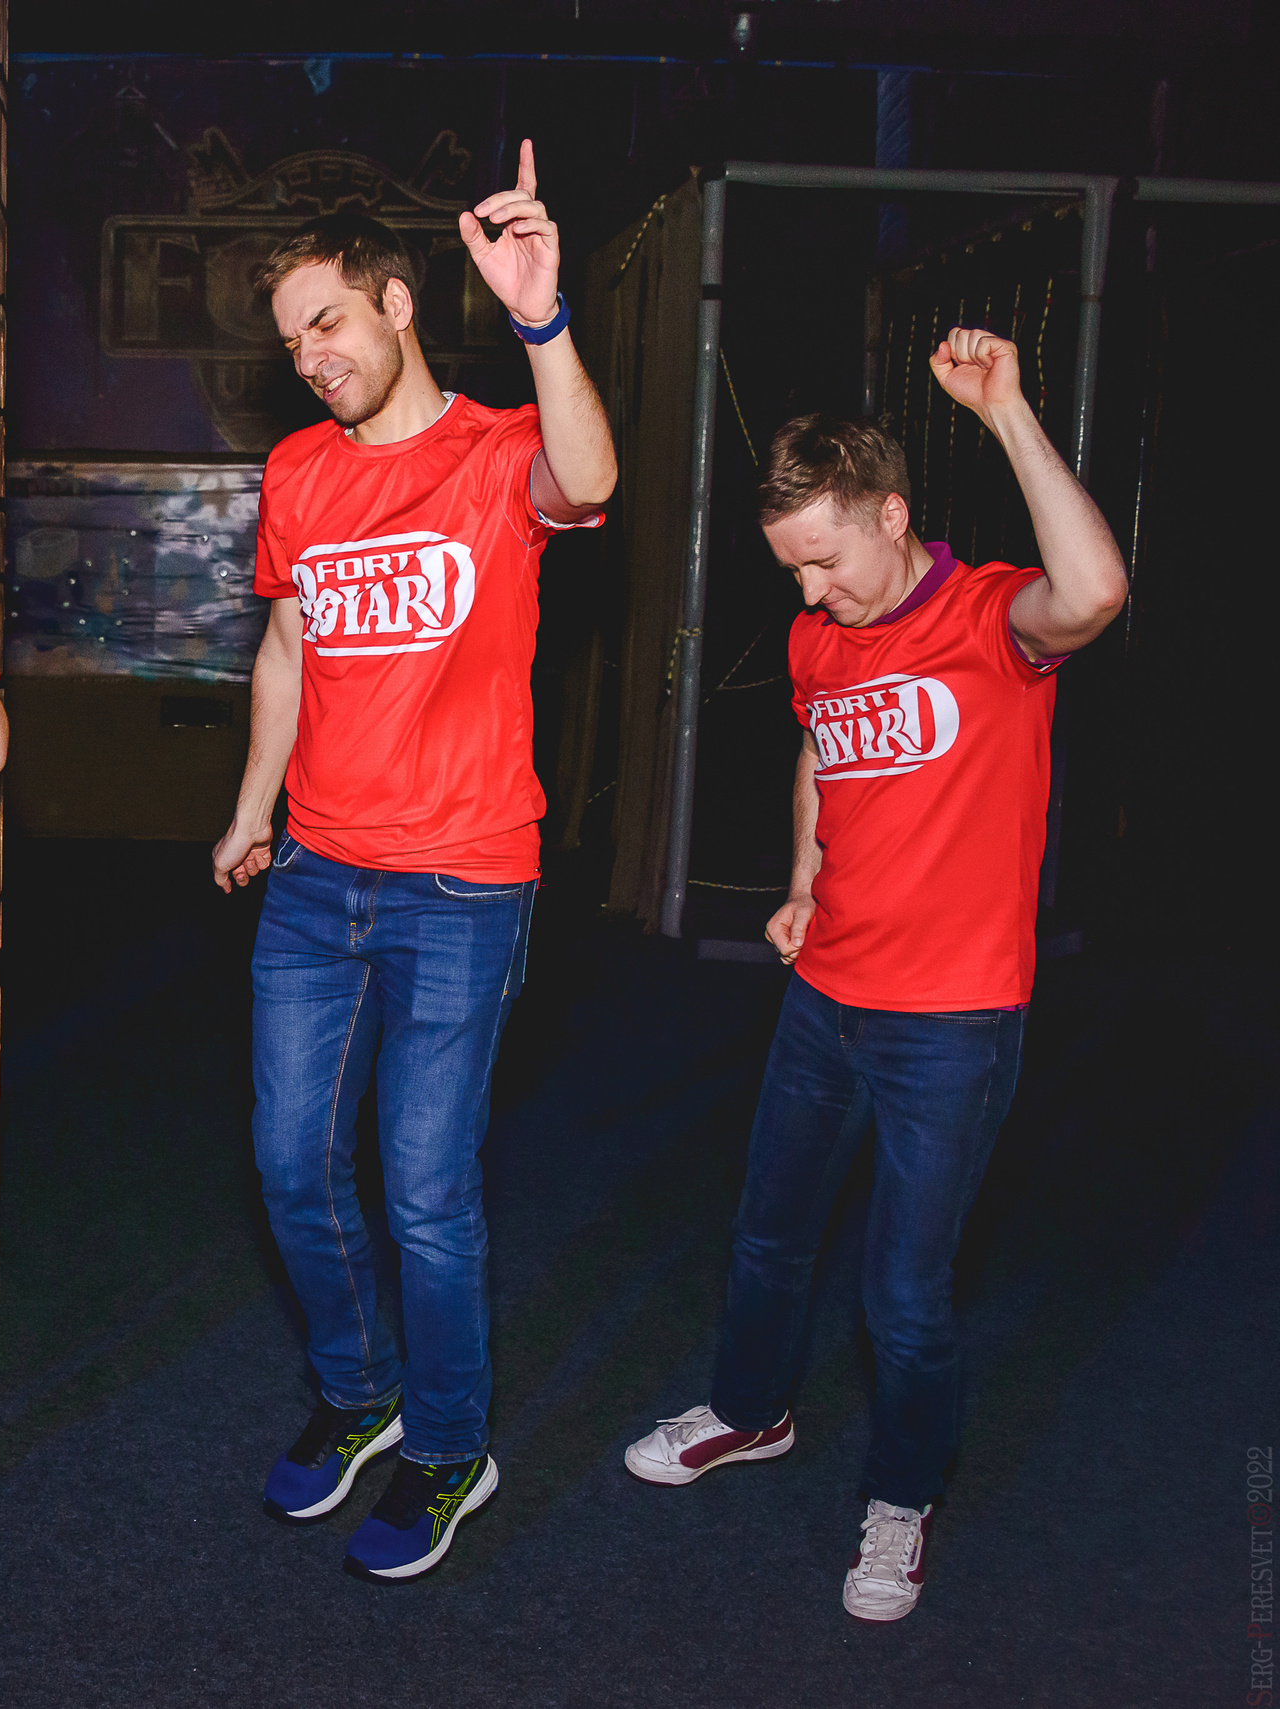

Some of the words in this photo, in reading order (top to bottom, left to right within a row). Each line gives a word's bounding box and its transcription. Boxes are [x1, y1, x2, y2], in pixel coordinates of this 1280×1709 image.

[316, 551, 415, 583] FORT
[813, 690, 887, 718] FORT
[806, 677, 960, 771] OYARD
